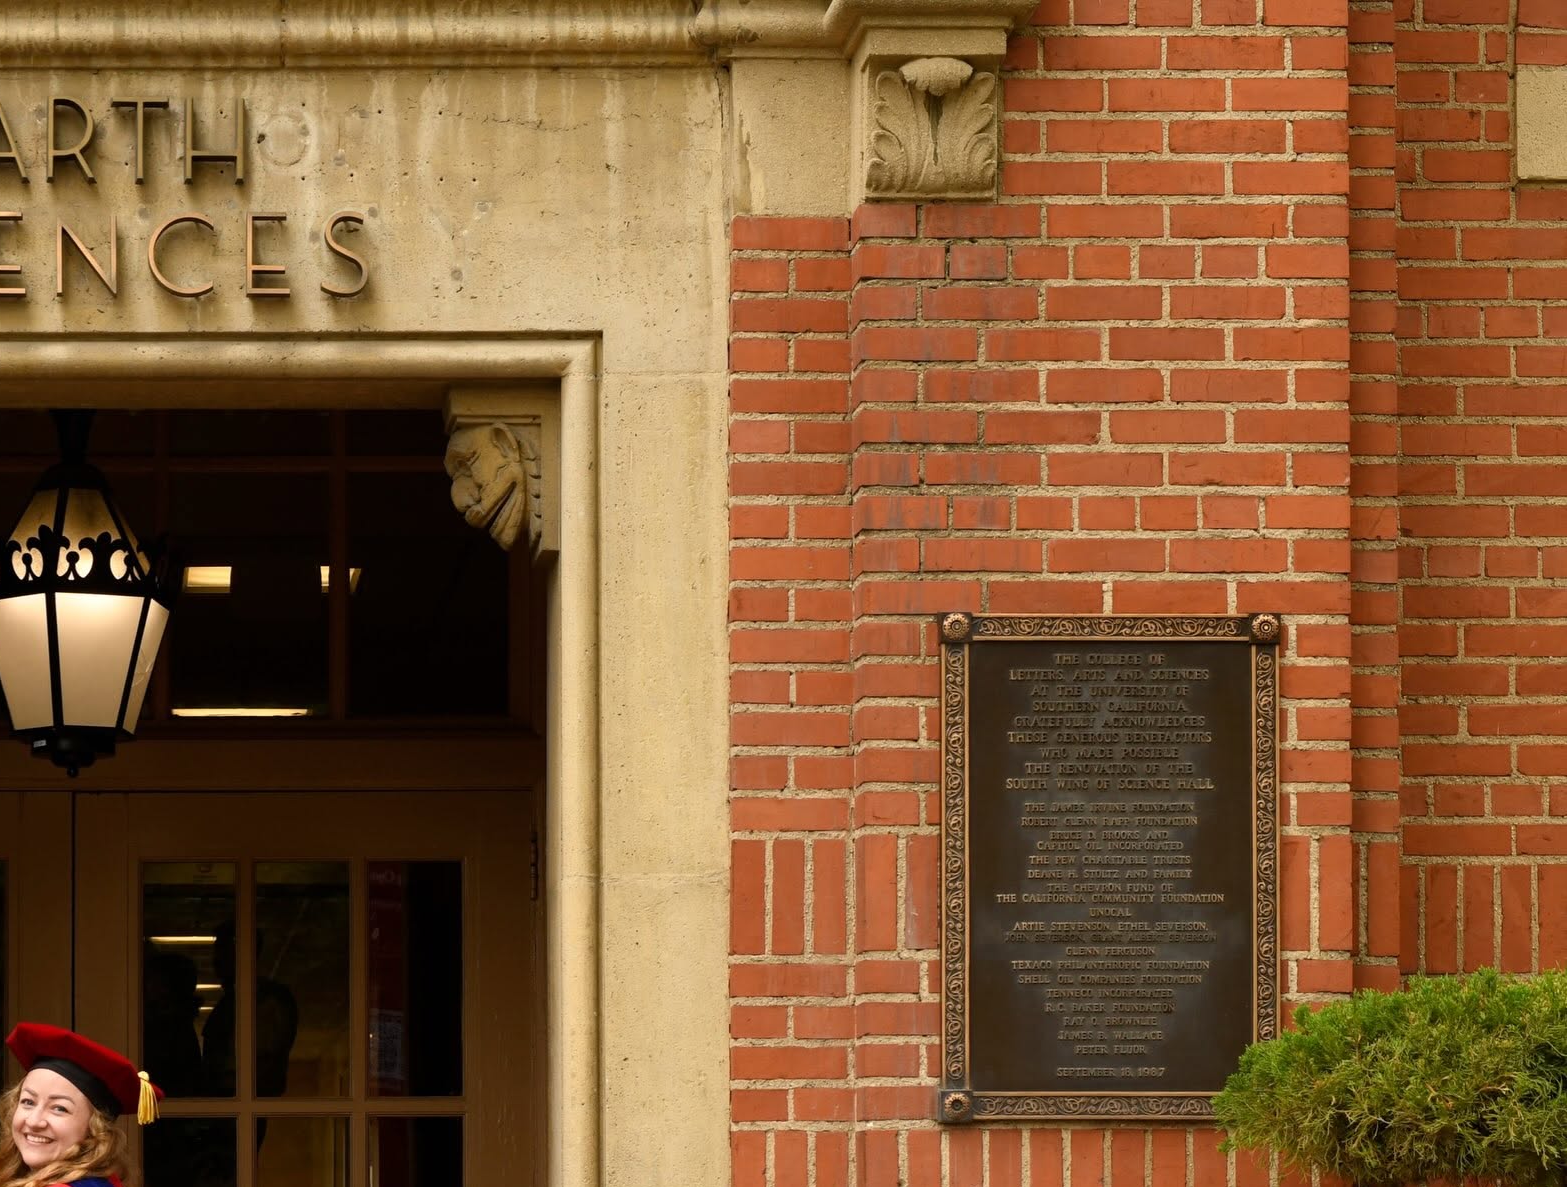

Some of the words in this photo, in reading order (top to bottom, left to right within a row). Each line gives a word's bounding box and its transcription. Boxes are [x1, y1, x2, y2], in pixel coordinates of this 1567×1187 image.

[1054, 654, 1080, 666] THE
[1088, 654, 1142, 666] COLLEGE
[1148, 654, 1166, 666] OF
[1072, 669, 1106, 681] ARTS
[1113, 669, 1143, 681] AND
[1151, 669, 1210, 681] SCIENCES
[1031, 685, 1050, 697] AT
[1056, 685, 1082, 697] THE
[1089, 685, 1168, 697] UNIVERSITY
[1175, 685, 1189, 697] OF
[1032, 701, 1100, 712] SOUTHERN
[1107, 701, 1186, 712] CALIFORNIA
[1014, 716, 1095, 728] GRATEFULLY
[1102, 716, 1206, 728] ACKNOWLEDGES
[1008, 732, 1048, 744] THESE
[1056, 732, 1120, 744] GENEROUS
[1125, 732, 1212, 744] BENEFACTORS
[1040, 747, 1068, 760] WHO
[1076, 747, 1113, 760] MADE
[1121, 747, 1180, 760] POSSIBLE
[1025, 763, 1051, 775] THE
[1058, 763, 1137, 775] RENOVATION
[1144, 763, 1159, 775] OF
[1168, 763, 1194, 775] THE
[1005, 778, 1047, 790] SOUTH
[1056, 778, 1090, 790] WING
[1096, 778, 1110, 790] OF
[1118, 778, 1170, 790] SCIENCE
[1177, 778, 1215, 790] HALL
[1025, 803, 1046, 813] THE
[1051, 803, 1085, 813] JAMES
[1131, 803, 1194, 813] FOUNDATION
[1021, 817, 1057, 827] ROBERT
[1064, 817, 1098, 827] GLENN
[1135, 817, 1198, 827] FOUNDATION
[1050, 831, 1082, 841] BRUCE
[1102, 831, 1140, 841] BROOKS
[1146, 831, 1169, 841] AND
[1037, 841, 1081, 851] CAPITOL
[1085, 841, 1102, 851] OIL
[1107, 841, 1183, 851] INCORPORATED
[1029, 855, 1050, 865] THE
[1055, 855, 1076, 865] PEW
[1082, 855, 1148, 865] CHARITABLE
[1153, 855, 1191, 865] TRUSTS
[1027, 869, 1062, 879] DEANE
[1125, 869, 1148, 879] AND
[1153, 869, 1192, 879] FAMILY
[1048, 883, 1069, 892] THE
[1073, 883, 1122, 892] CHEVRON
[1126, 883, 1154, 892] FUND
[1161, 883, 1174, 892] OF
[996, 894, 1017, 903] THE
[1022, 894, 1086, 903] CALIFORNIA
[1091, 894, 1154, 903] COMMUNITY
[1161, 894, 1225, 903] FOUNDATION
[1089, 907, 1132, 917] UNOCAL
[1013, 922, 1046, 932] ARTIE
[1118, 922, 1151, 932] ETHEL
[1168, 933, 1217, 943] SEVERSON
[1066, 946, 1100, 956] GLENN
[1104, 946, 1155, 956] FERGUSON
[1010, 960, 1052, 970] TEXACO
[1058, 960, 1141, 970] PHILANTHROPIC
[1146, 960, 1210, 970] FOUNDATION
[1018, 974, 1051, 985] SHELL
[1057, 974, 1074, 985] OIL
[1079, 974, 1136, 985] COMPANIES
[1140, 974, 1202, 985] FOUNDATION
[1046, 989, 1094, 998] TENNECO
[1098, 989, 1173, 998] INCORPORATED
[1072, 1003, 1106, 1013] BAKER
[1112, 1003, 1177, 1013] FOUNDATION
[1064, 1016, 1085, 1026] RAY
[1057, 1031, 1093, 1040] JAMES
[1099, 1031, 1108, 1040] B.
[1113, 1031, 1163, 1040] WALLACE
[1074, 1045, 1108, 1055] PETER
[1056, 1067, 1115, 1078] SEPTEMBER
[1138, 1067, 1166, 1078] 1987
